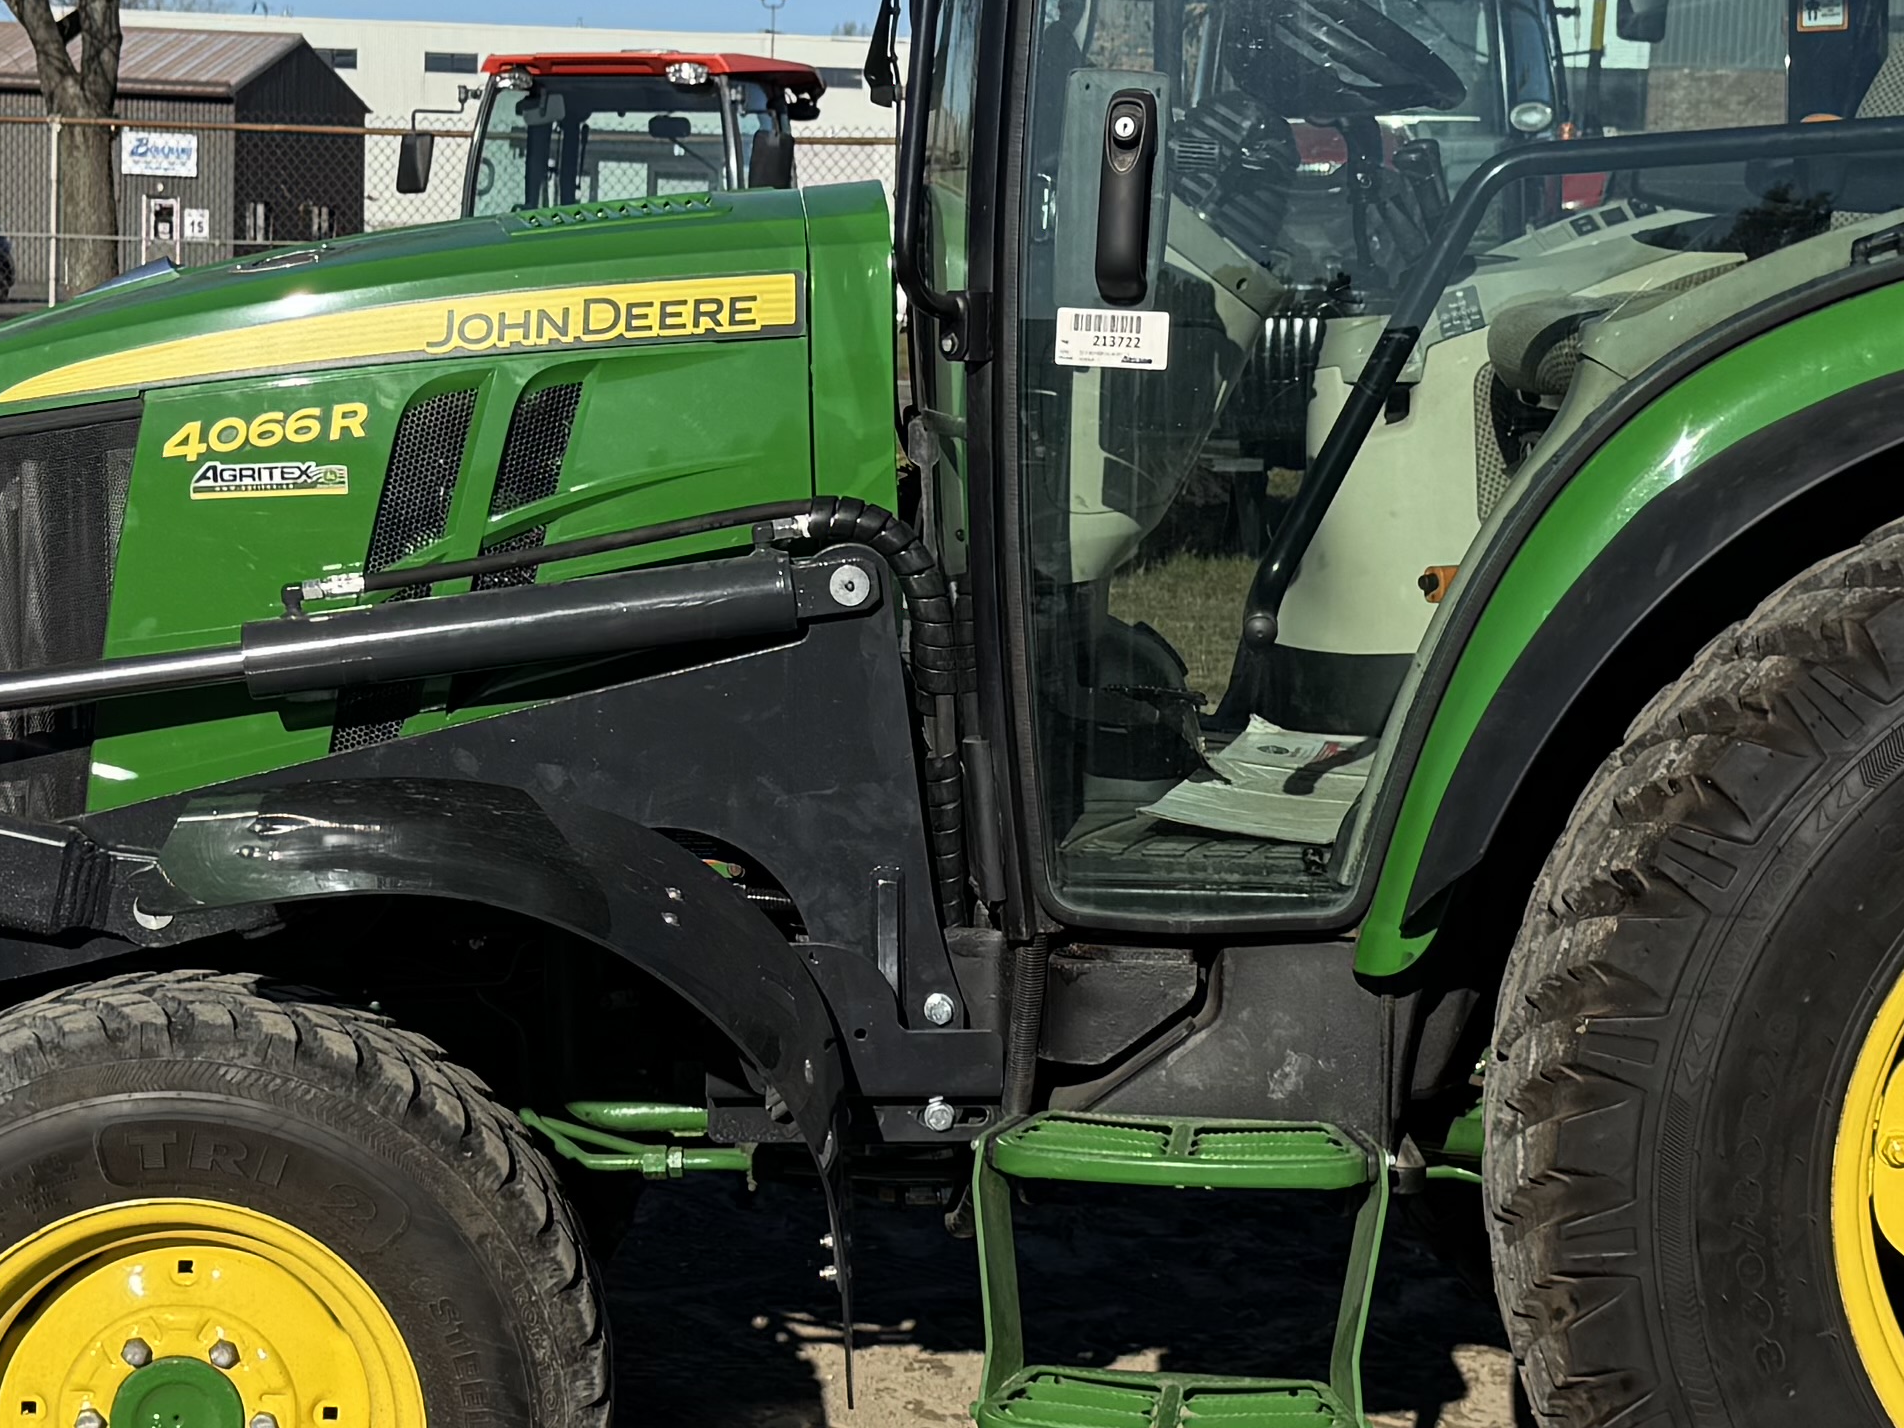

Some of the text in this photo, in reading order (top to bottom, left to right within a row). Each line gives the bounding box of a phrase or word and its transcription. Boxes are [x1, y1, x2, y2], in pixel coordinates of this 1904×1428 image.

[425, 294, 758, 349] JOHN DEERE
[1092, 335, 1142, 349] 213722
[195, 464, 313, 483] AGRITEX
[124, 1129, 289, 1190] TRI
[318, 1182, 379, 1236] 2
